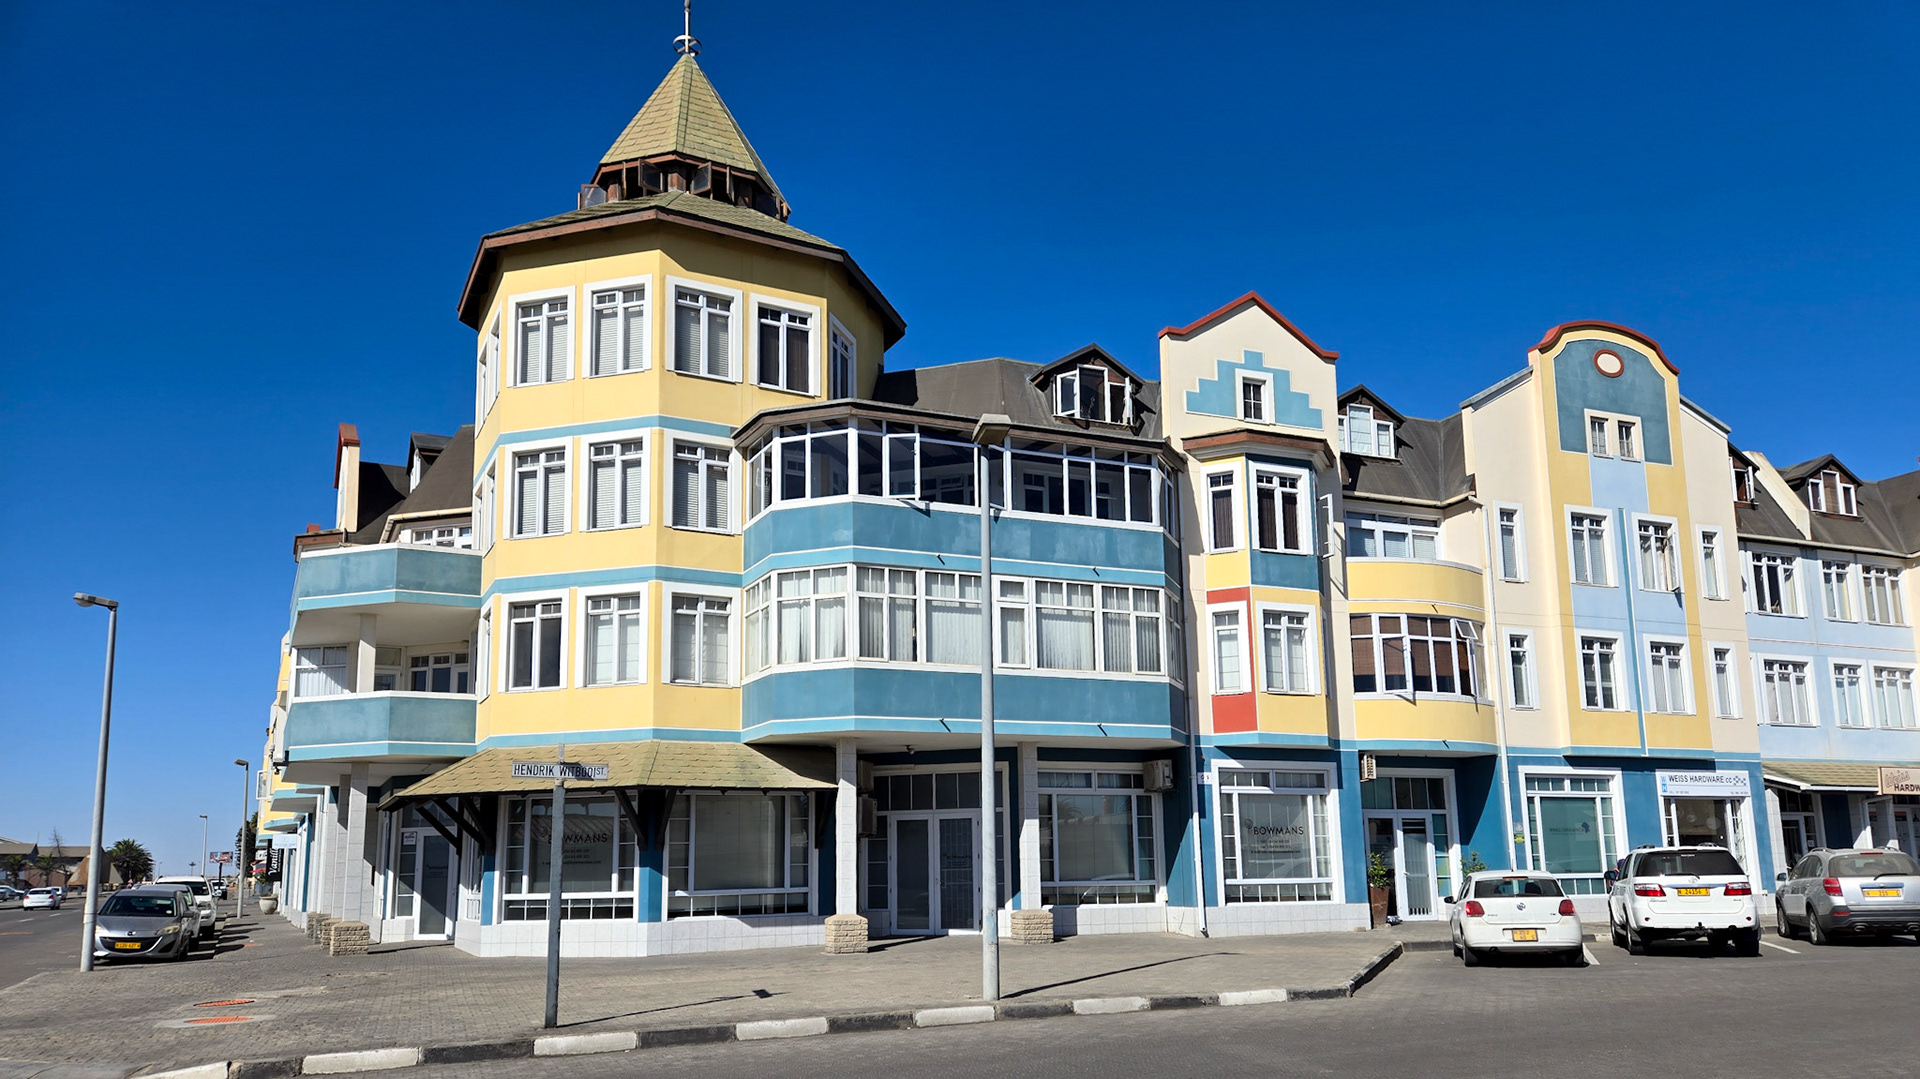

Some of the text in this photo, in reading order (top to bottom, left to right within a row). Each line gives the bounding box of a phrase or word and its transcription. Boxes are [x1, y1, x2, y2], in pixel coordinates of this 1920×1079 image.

[514, 764, 555, 776] HENDRIK
[560, 765, 596, 777] WITBOOI
[1668, 774, 1688, 783] WEISS
[1689, 775, 1725, 784] HARDWARE
[1253, 826, 1304, 835] BOWMANS
[548, 832, 608, 845] BWMANS
